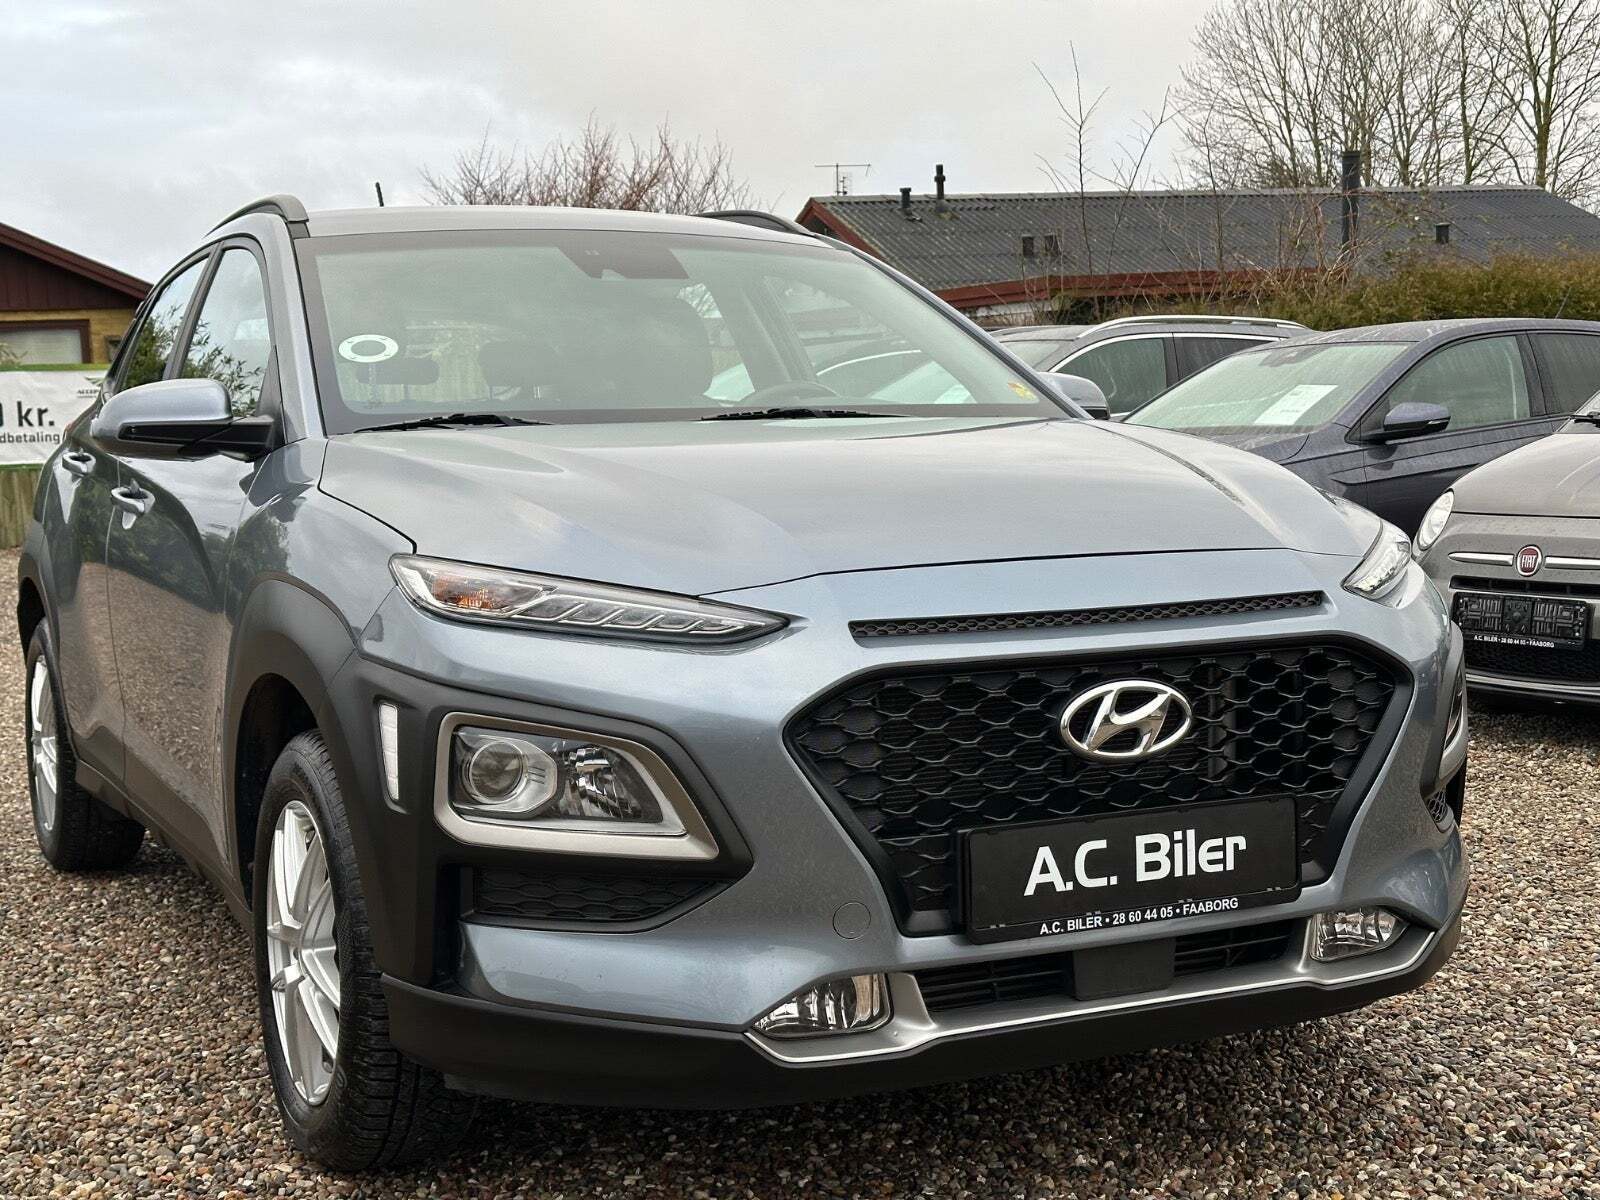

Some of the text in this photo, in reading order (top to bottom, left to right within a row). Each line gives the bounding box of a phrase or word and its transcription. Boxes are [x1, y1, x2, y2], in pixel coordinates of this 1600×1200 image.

[17, 400, 55, 427] kr.
[0, 432, 60, 444] dbetaling
[1521, 554, 1537, 568] FIAT
[1023, 829, 1247, 896] A.C. Biler
[1040, 897, 1239, 935] A.C. BILER 28 60 44 05 FAABORG
